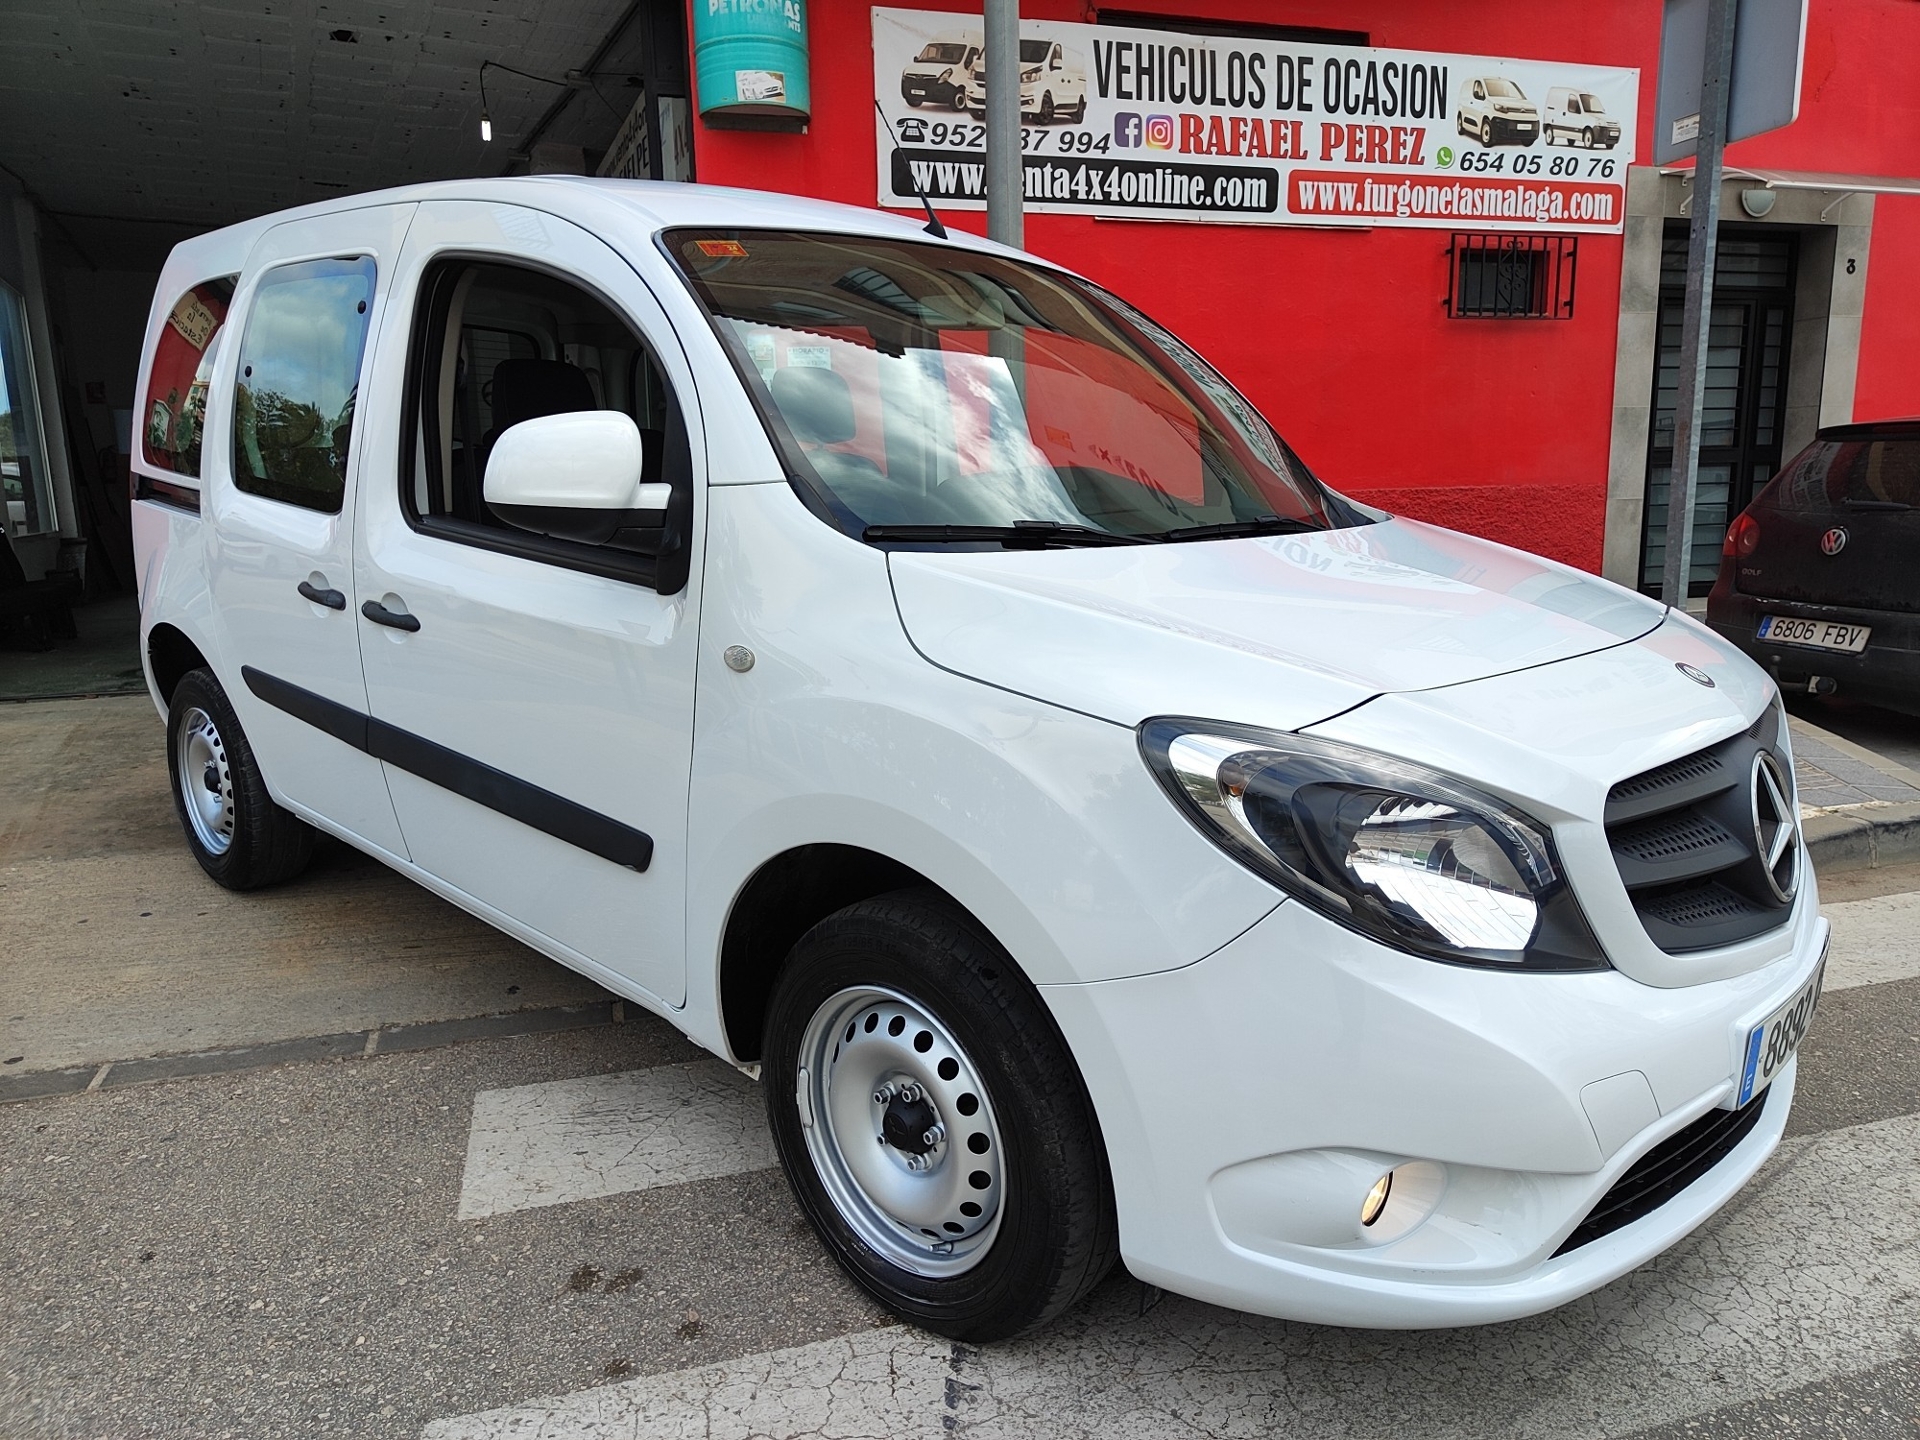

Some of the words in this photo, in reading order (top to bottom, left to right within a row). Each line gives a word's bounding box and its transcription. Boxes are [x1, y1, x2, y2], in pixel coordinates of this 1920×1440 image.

[708, 0, 800, 22] PETRONAS
[1093, 39, 1266, 109] VEHICULOS
[1276, 55, 1313, 112] DE
[1323, 57, 1448, 119] OCASION
[929, 122, 986, 149] 952
[1058, 131, 1111, 155] 994
[1178, 113, 1308, 160] RAFAEL
[1320, 122, 1426, 165] PEREZ
[1459, 151, 1505, 173] 654
[1512, 154, 1543, 175] 05
[1549, 156, 1579, 177] 80
[1586, 158, 1616, 178] 76
[1298, 178, 1613, 222] www.furgonetasmalaga.com
[1846, 259, 1855, 275] 3
[1772, 619, 1817, 641] 6806
[1821, 624, 1863, 648] FBV
[1763, 985, 1813, 1078] 8892
